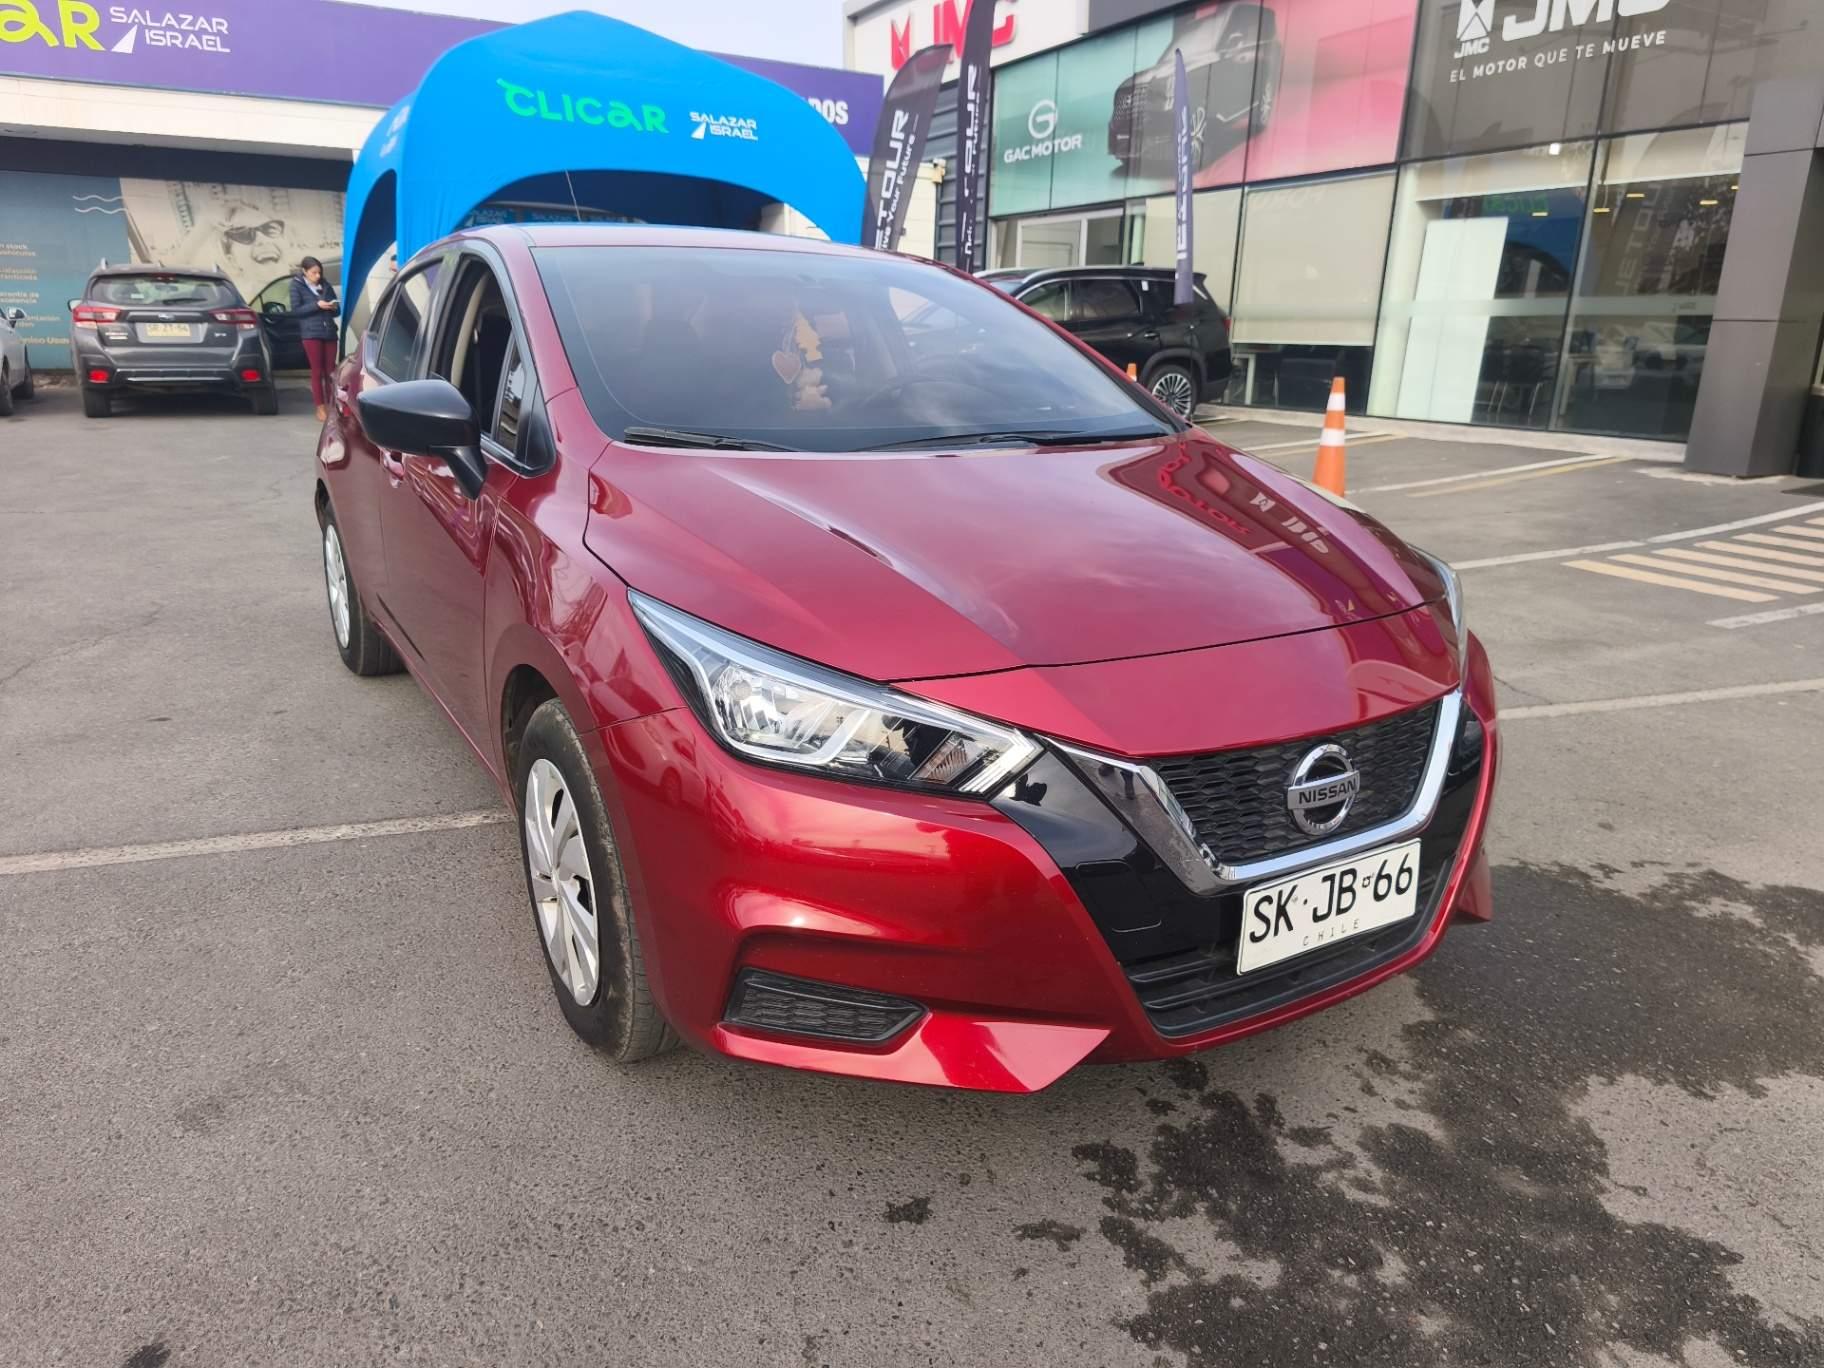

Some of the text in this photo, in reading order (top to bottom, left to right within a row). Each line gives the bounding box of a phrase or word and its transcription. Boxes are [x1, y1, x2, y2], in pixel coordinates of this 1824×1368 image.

[109, 6, 229, 34] SALAZAR
[145, 30, 231, 52] ISRAEL
[1454, 38, 1490, 58] JMC
[1450, 31, 1666, 82] EL MOTOR QUE TE NUEVE
[689, 112, 757, 130] SALAZAR
[709, 124, 758, 140] ISRAEL
[1004, 133, 1083, 163] GAC MOTOR
[1299, 778, 1357, 804] NISSAN
[1303, 919, 1360, 947] CHILE
